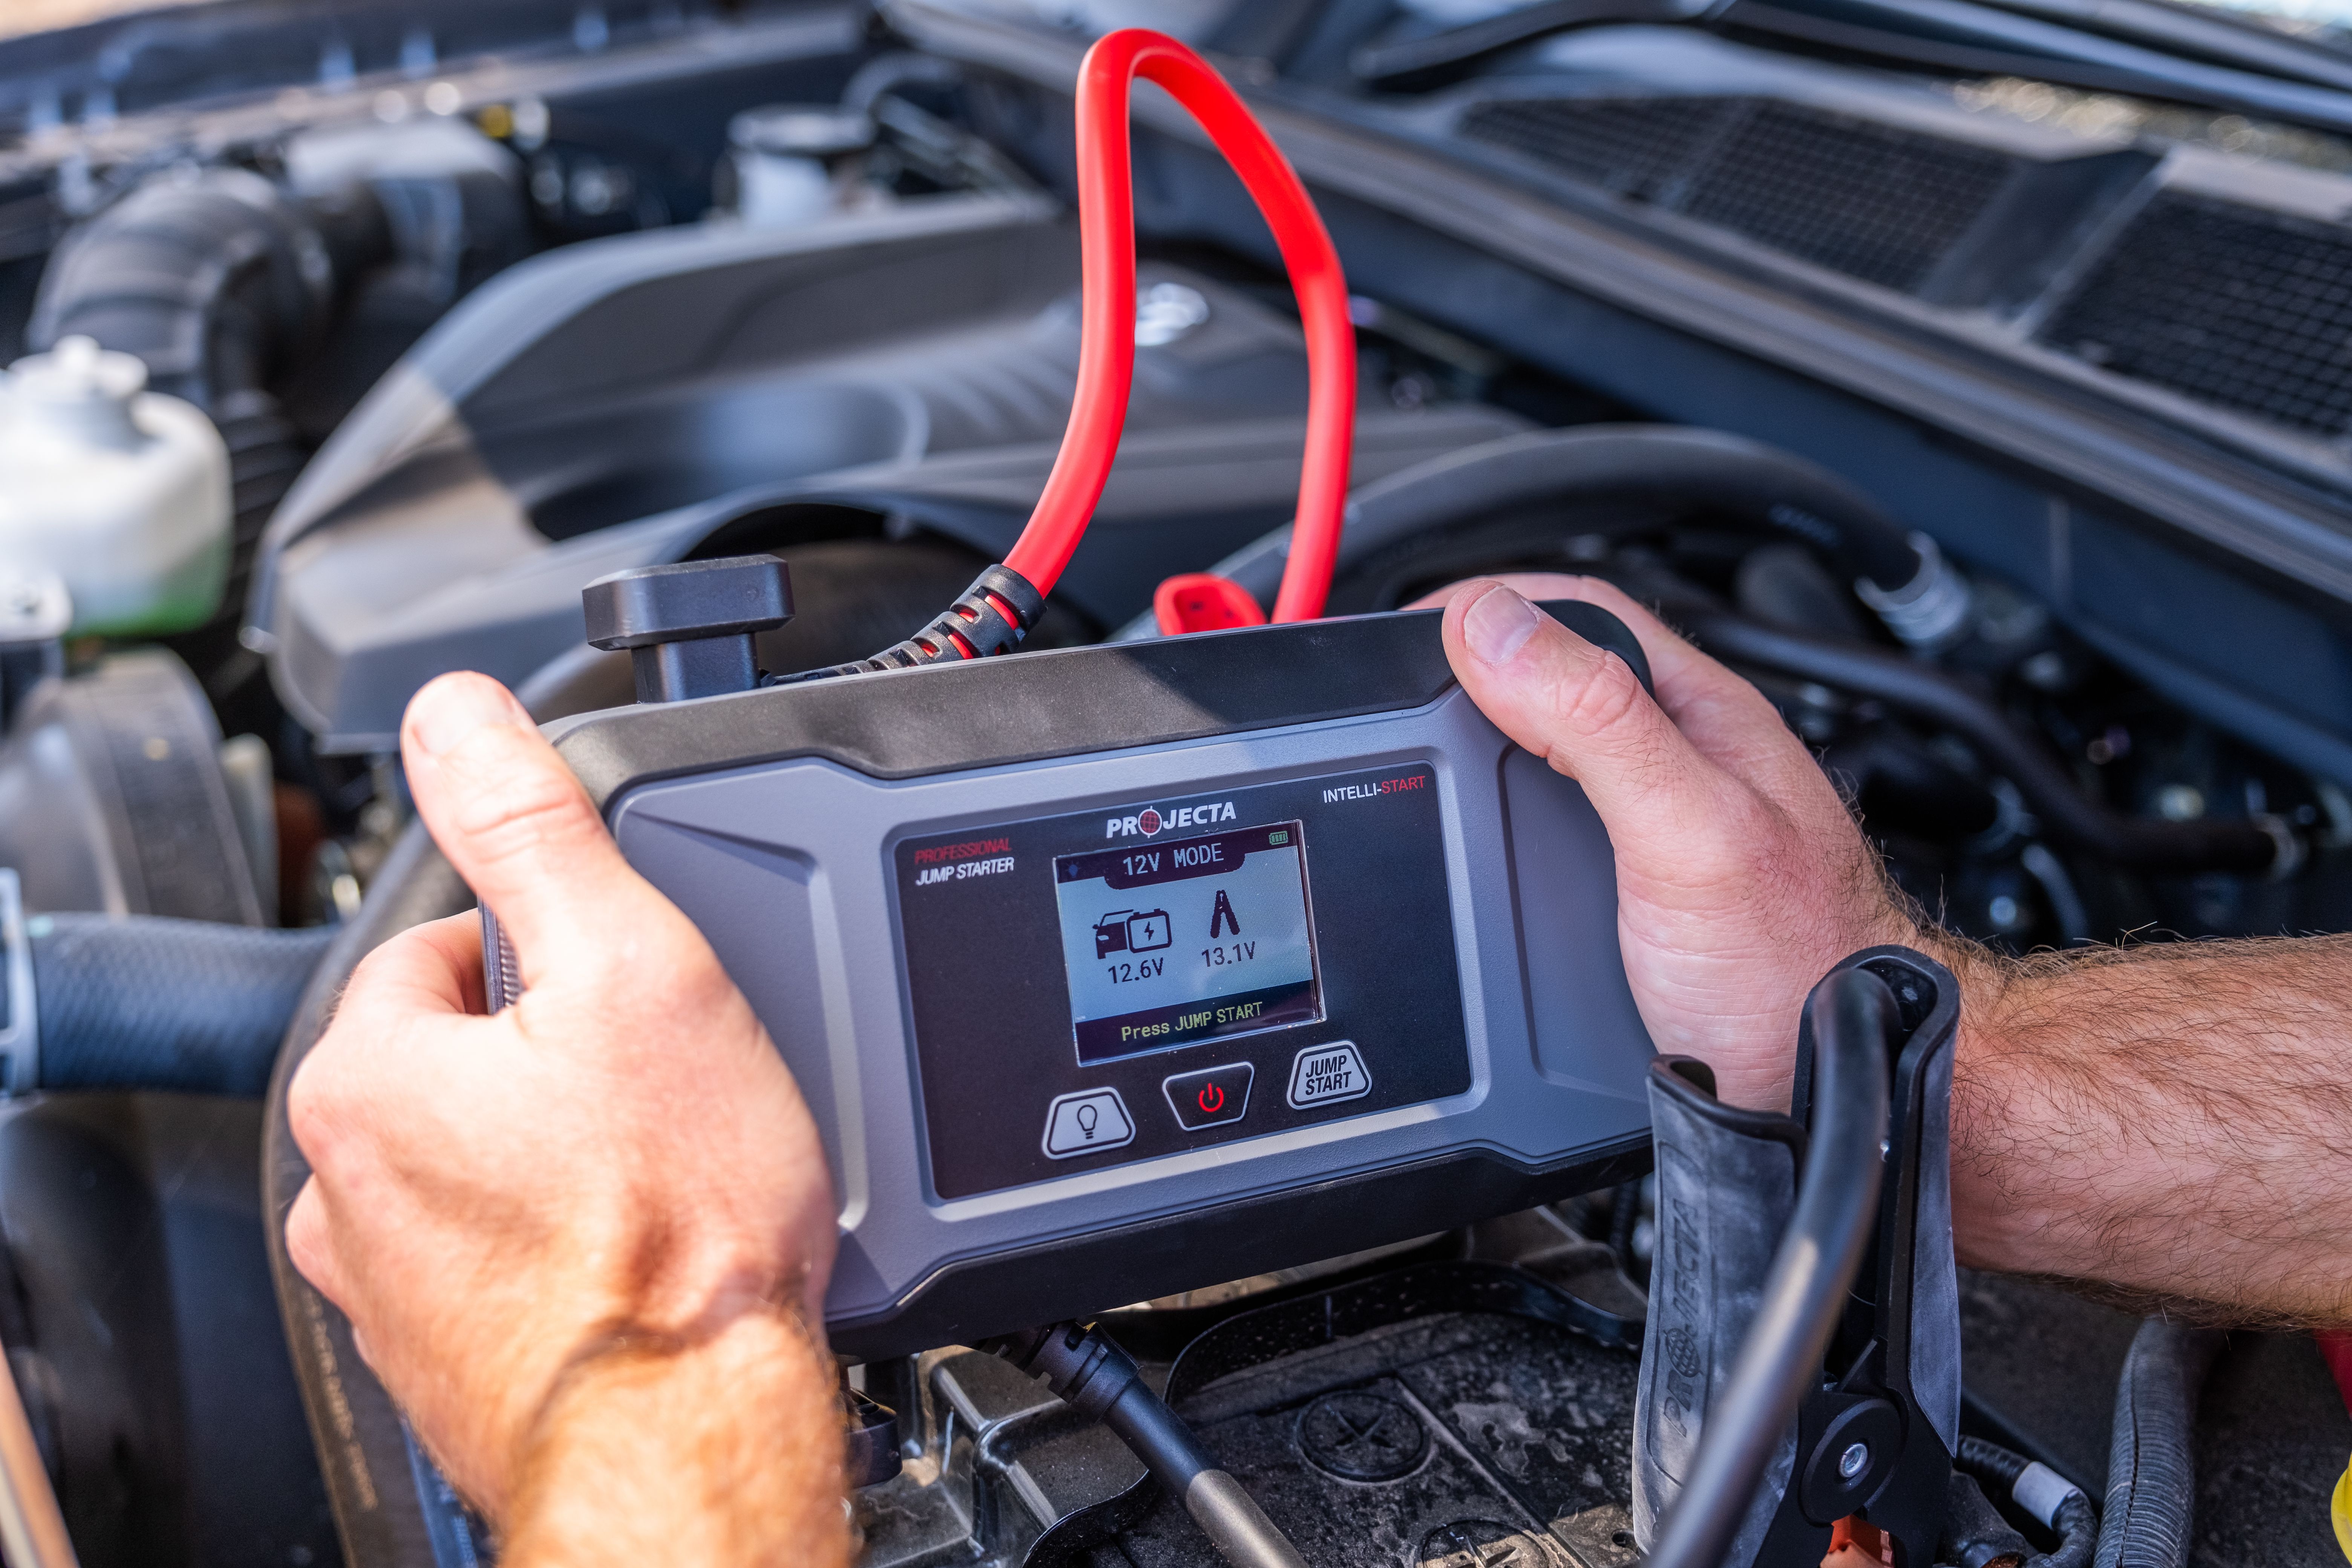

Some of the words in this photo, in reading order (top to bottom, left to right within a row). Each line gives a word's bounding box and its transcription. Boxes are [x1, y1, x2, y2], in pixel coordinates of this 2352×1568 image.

[1323, 775, 1426, 803] INTELLI-START
[1106, 801, 1236, 839] PROJECTA
[914, 838, 1012, 865] PROFESSIONAL
[1123, 852, 1160, 876] 12V
[1173, 843, 1224, 868] MODE
[915, 866, 955, 886] JUMP
[956, 856, 1015, 880] STARTER
[1201, 941, 1256, 967] 13.1V
[1107, 957, 1164, 984] 12.6V
[1121, 1022, 1170, 1041] Press
[1175, 1011, 1212, 1031] JUMP
[1216, 1001, 1263, 1023] START
[1306, 1055, 1347, 1078] JUMP
[1305, 1070, 1352, 1096] START
